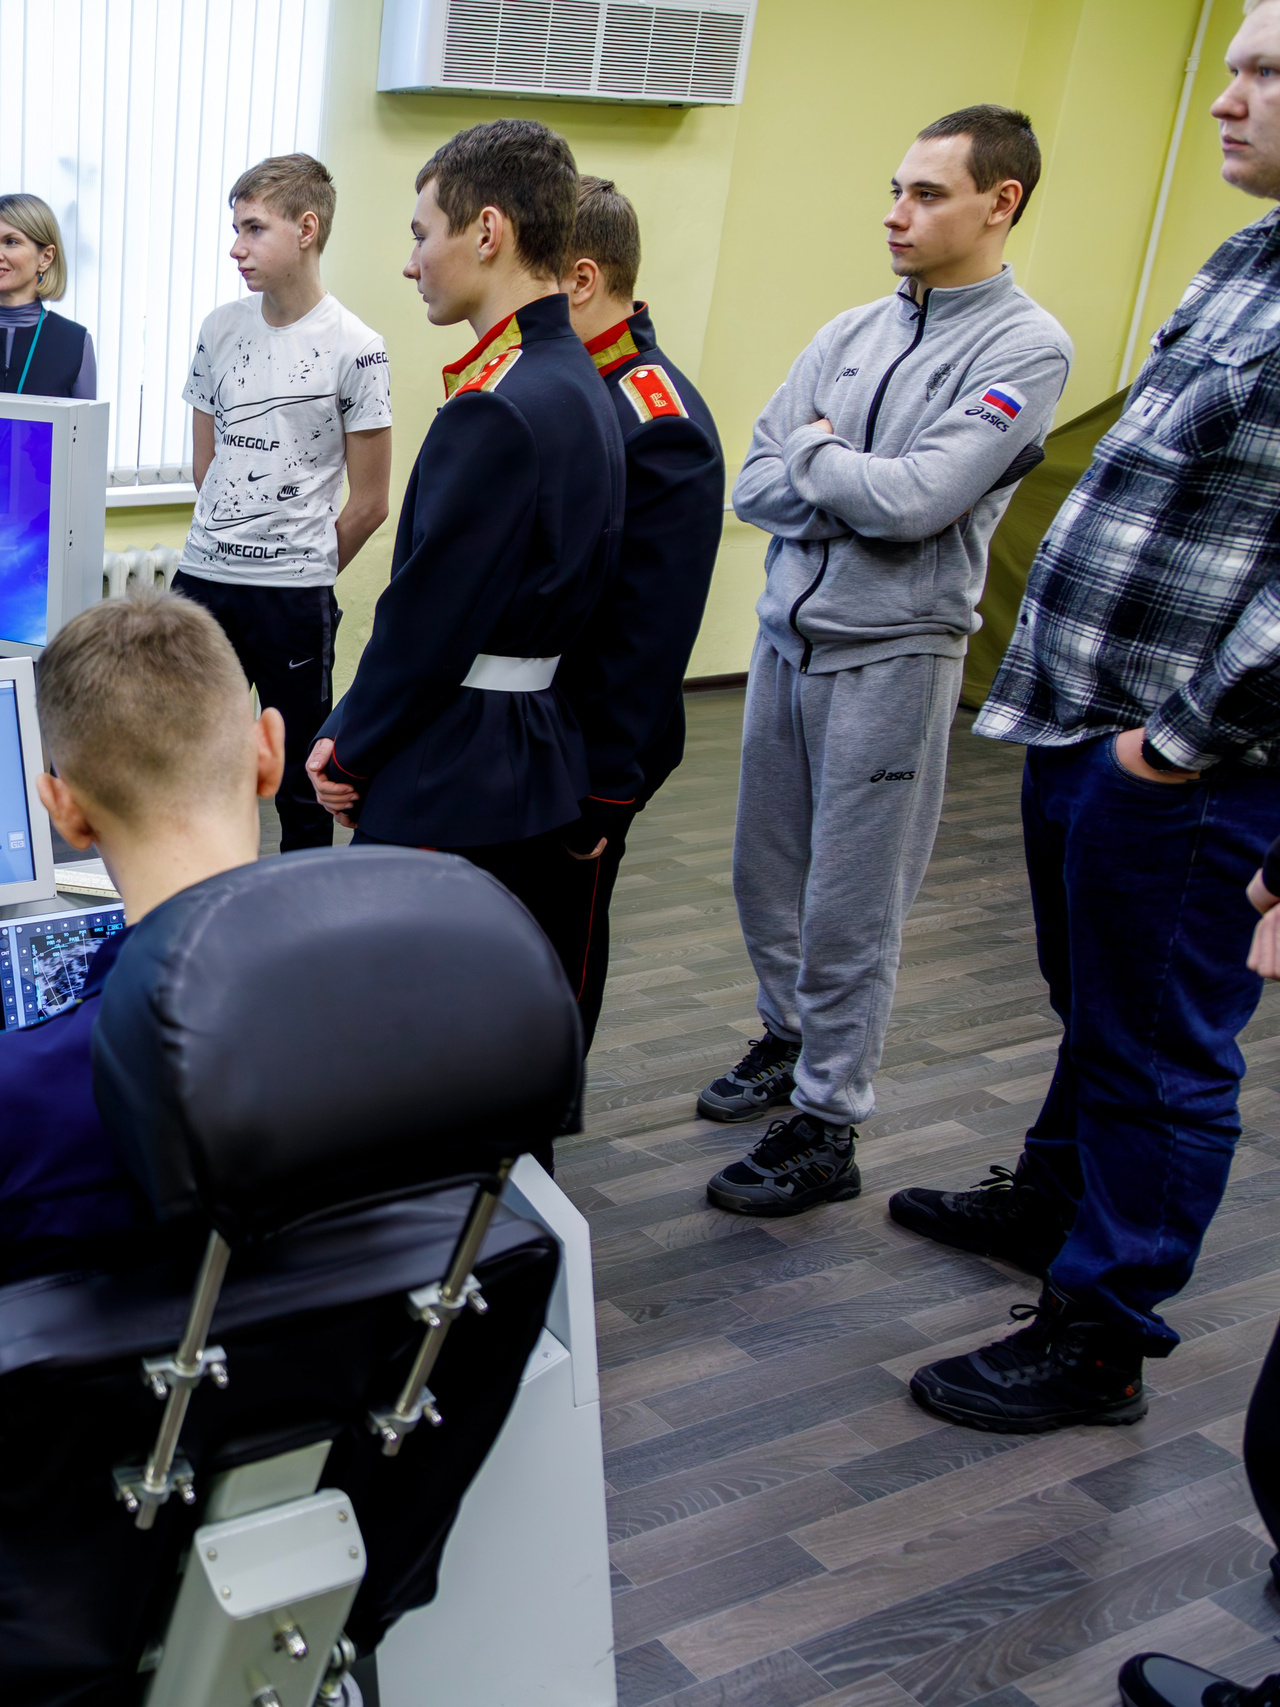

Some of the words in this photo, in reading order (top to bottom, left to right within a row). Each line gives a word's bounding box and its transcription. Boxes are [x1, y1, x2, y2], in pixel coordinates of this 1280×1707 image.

[980, 411, 1010, 432] asics
[222, 434, 280, 452] NIKEGOLF
[280, 485, 300, 495] NIKE
[216, 541, 287, 558] NIKEGOLF
[885, 770, 916, 781] asics
